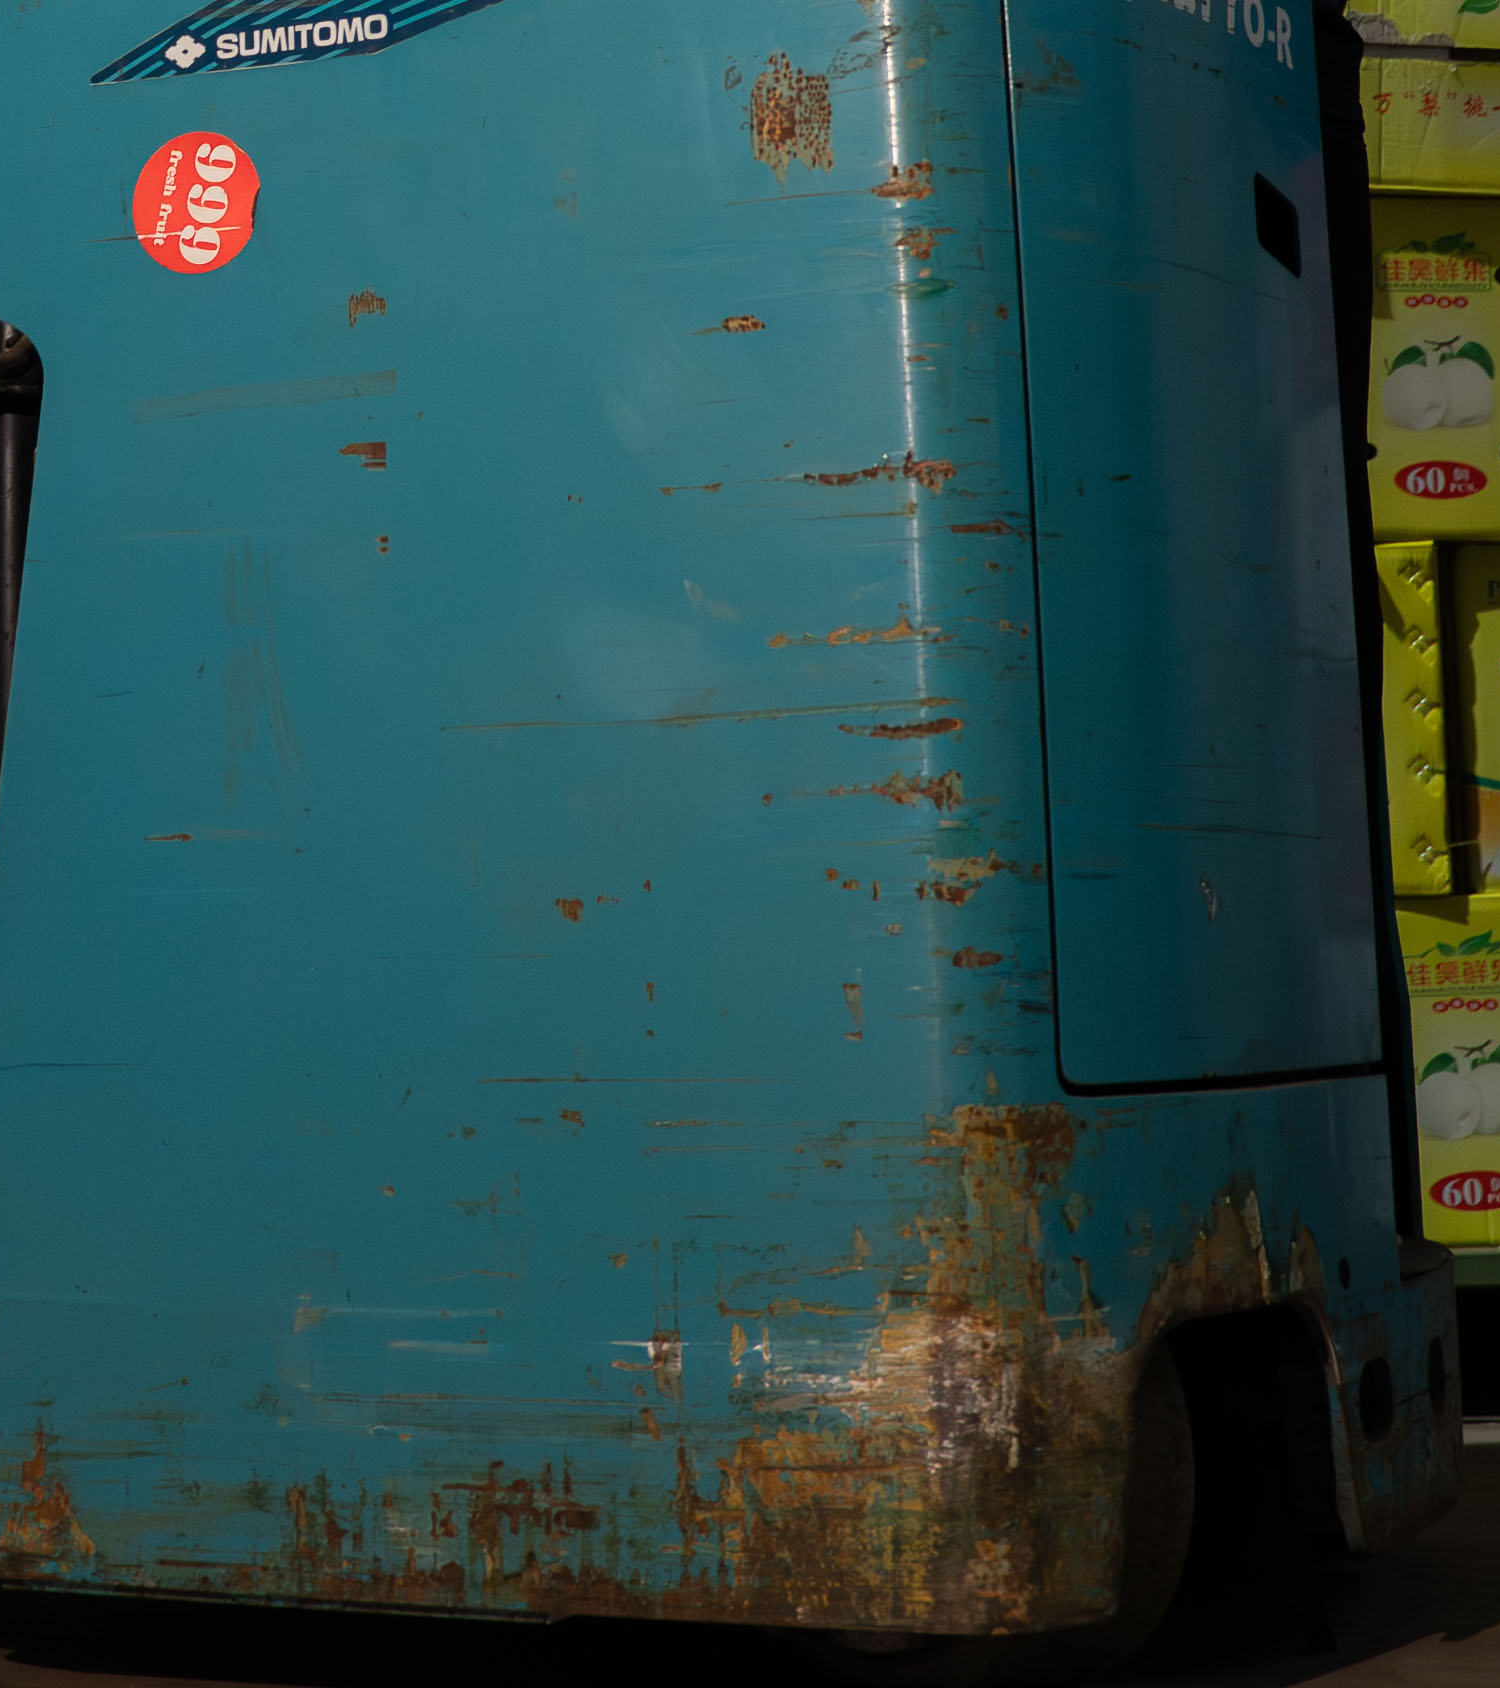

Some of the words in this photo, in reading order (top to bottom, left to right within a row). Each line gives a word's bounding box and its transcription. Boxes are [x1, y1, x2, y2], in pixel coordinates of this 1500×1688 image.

[215, 12, 389, 60] SUMITOMO
[162, 150, 182, 198] fresh
[153, 203, 171, 247] fruit
[178, 140, 238, 266] 999
[1378, 255, 1489, 285] 佳昊鲜果
[1404, 467, 1449, 497] 60
[1442, 1178, 1483, 1207] 60
